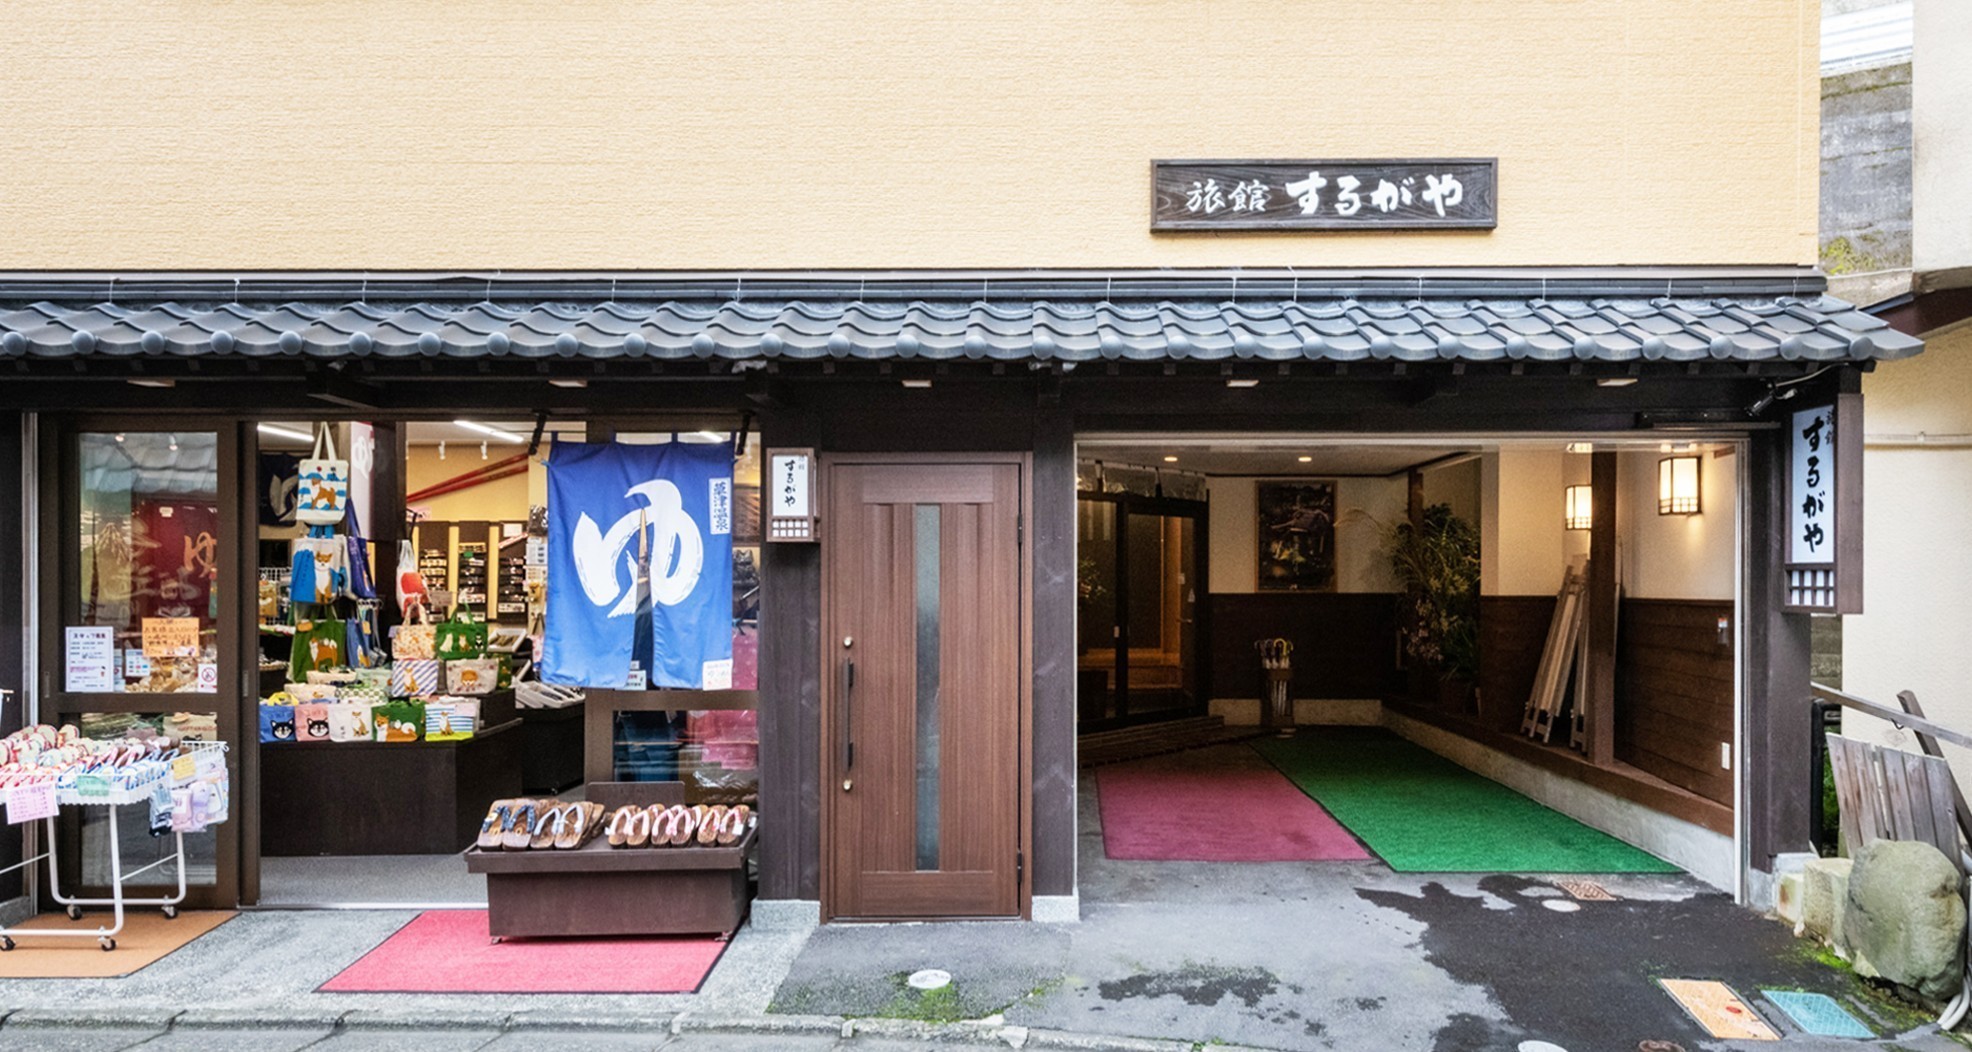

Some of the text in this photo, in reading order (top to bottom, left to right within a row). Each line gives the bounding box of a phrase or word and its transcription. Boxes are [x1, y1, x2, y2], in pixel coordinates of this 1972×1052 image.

[1186, 171, 1463, 217] 旅館 するがや
[785, 460, 796, 507] するがや
[1803, 416, 1825, 553] するがや
[184, 531, 217, 578] ゆ
[573, 479, 704, 618] ゆ
